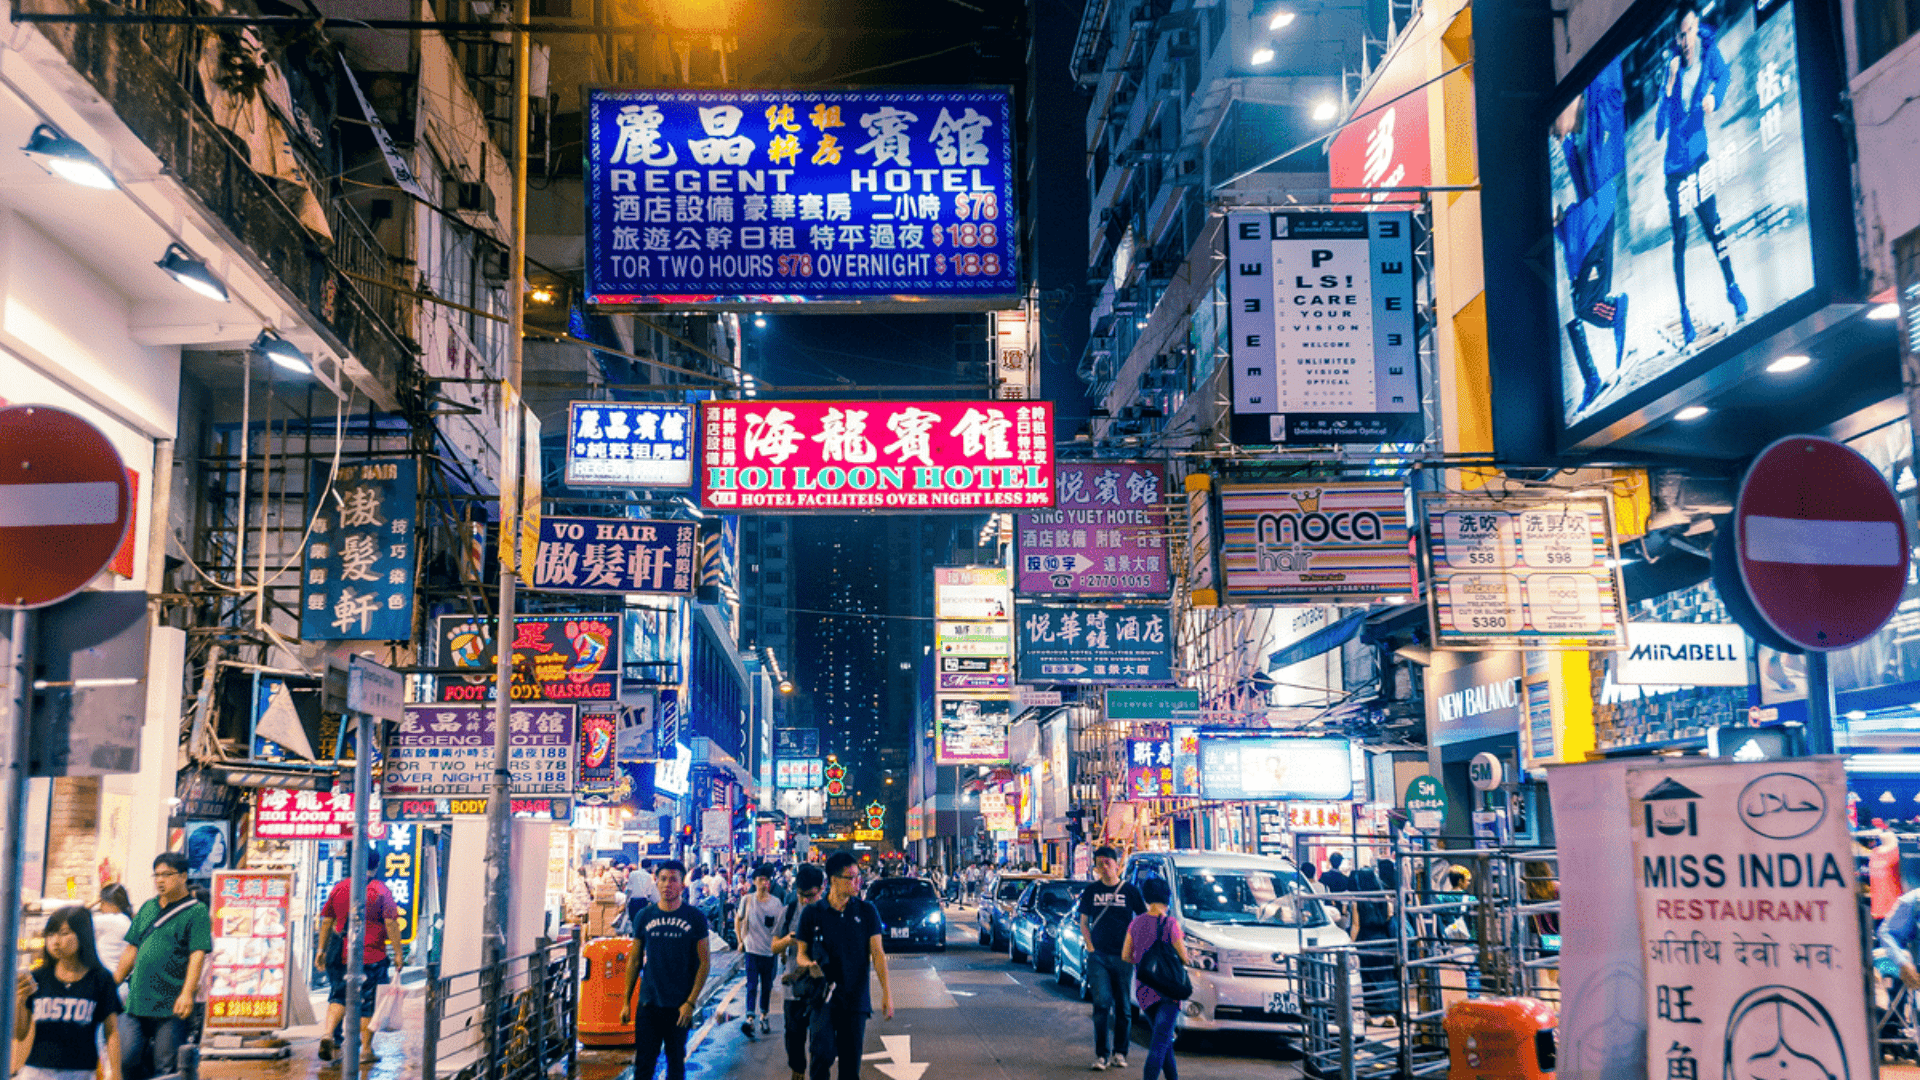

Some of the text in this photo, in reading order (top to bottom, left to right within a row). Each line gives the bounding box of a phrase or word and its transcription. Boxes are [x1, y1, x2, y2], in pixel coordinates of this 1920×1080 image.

[611, 104, 755, 166] 麗晶
[855, 106, 993, 166] 賓館
[611, 168, 995, 191] REGENT HOTEL
[612, 192, 998, 223] 酒店設備 豪華套房 二小時 $78
[931, 224, 998, 247] $188
[611, 253, 1001, 278] TOR TWO HOURS $78 OVERNIGHT $188
[1312, 250, 1333, 268] P
[1294, 295, 1357, 305] CARE
[1300, 310, 1351, 318] YOUR
[1293, 324, 1359, 332] VISION
[744, 406, 1013, 466] 海龍賓館
[707, 465, 1048, 490] HOI LOON HOTEL
[741, 493, 795, 505] HOTEL
[886, 493, 929, 505] OVER
[932, 492, 983, 505] NIGHT
[987, 492, 1023, 504] LESS
[1069, 510, 1103, 524] YUET
[1107, 510, 1152, 524] HOTEL
[1459, 515, 1498, 532] 洗吹
[553, 523, 658, 542] VO HAIR
[1258, 512, 1382, 543] moca
[1258, 546, 1312, 572] hair
[1470, 553, 1495, 564] $58
[1547, 553, 1572, 563] $98
[1472, 617, 1506, 628] $380
[444, 685, 486, 701] FOOT
[510, 684, 542, 699] ODY
[544, 682, 612, 699] MASSAGE
[1111, 699, 1196, 709] forever studio
[1438, 692, 1464, 722] NEW
[511, 735, 568, 745] OTEL
[387, 761, 419, 771] FOR
[430, 761, 465, 770] TWO
[535, 760, 567, 770] $78
[387, 773, 433, 783] OVER
[443, 772, 492, 782] NIGHT
[536, 771, 567, 782] 188
[403, 800, 435, 814] FOOT
[451, 800, 487, 814] BODY
[259, 811, 331, 821] HOI LOON
[1643, 852, 1847, 888] MISS INDIA
[1657, 899, 1829, 922] RESTAURANT
[645, 916, 692, 931] HOLLISTER
[33, 997, 97, 1022] BOSTON
